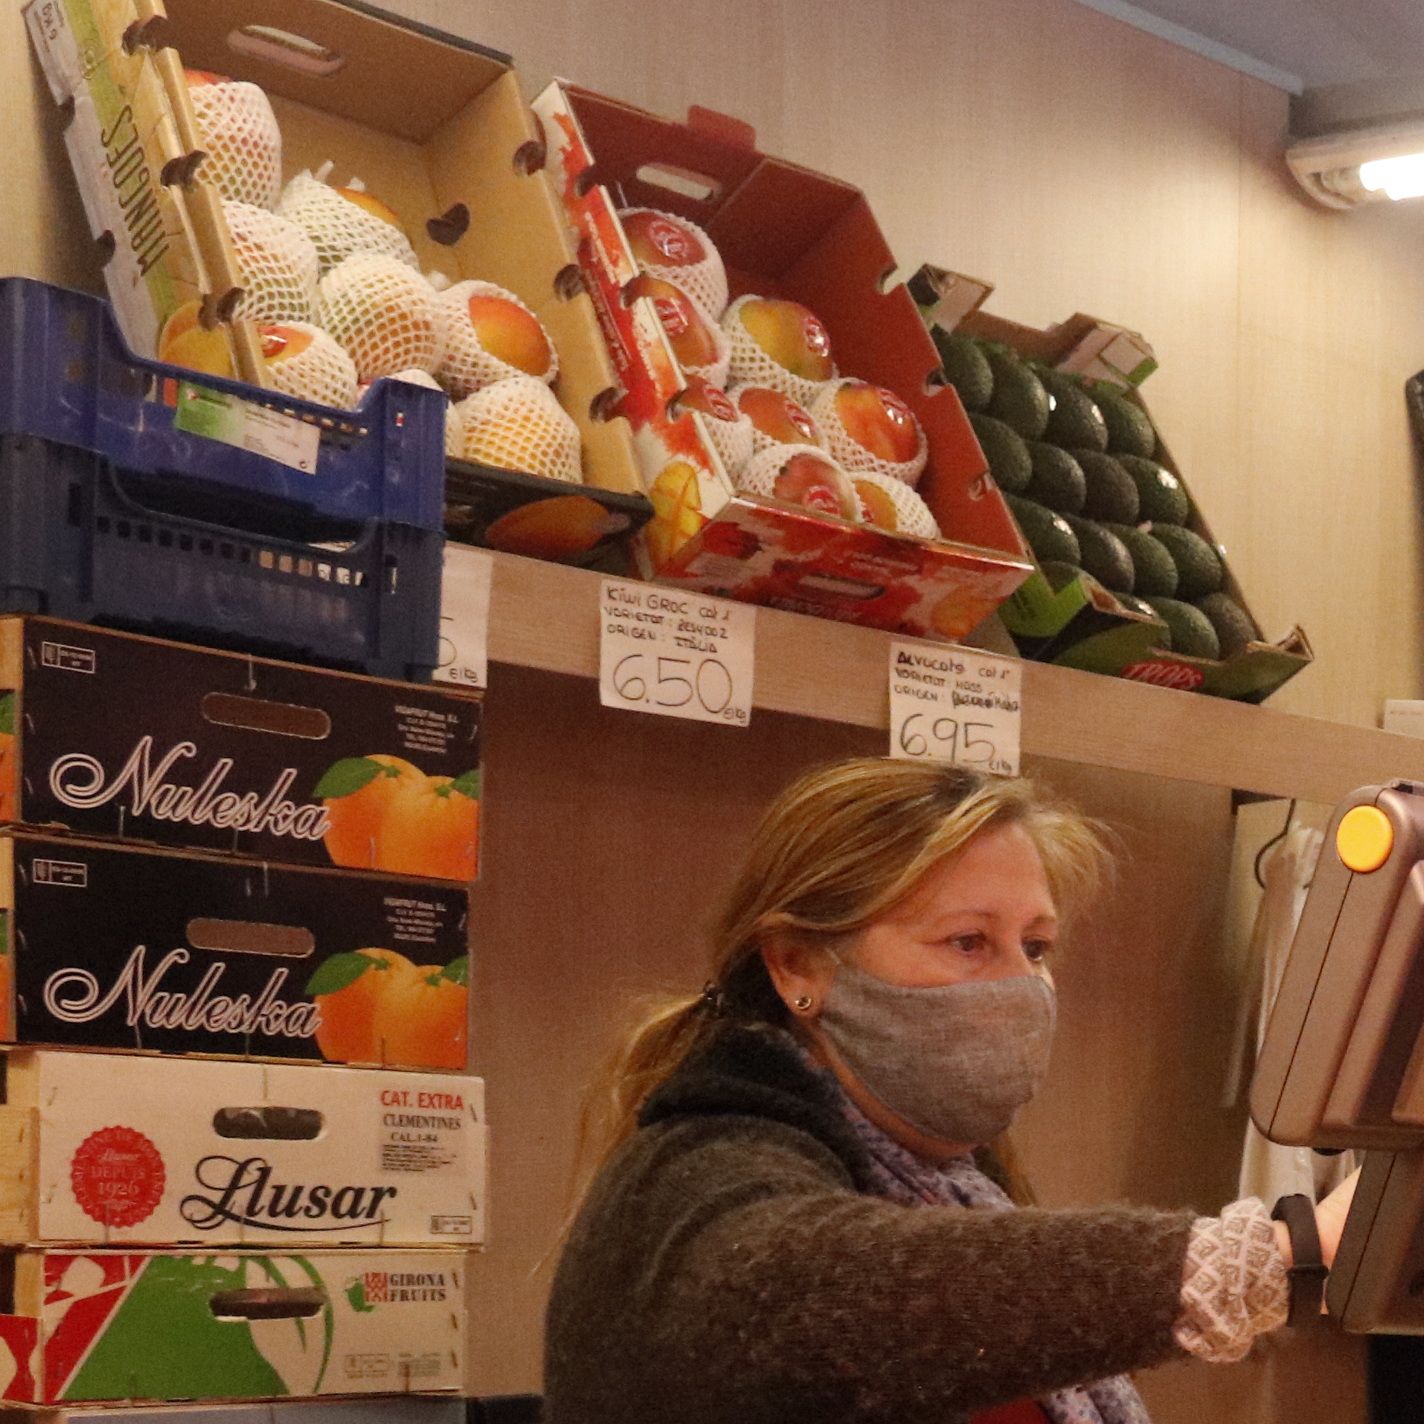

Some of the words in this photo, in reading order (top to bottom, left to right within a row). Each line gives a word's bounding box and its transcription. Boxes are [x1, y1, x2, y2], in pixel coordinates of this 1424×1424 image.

[101, 104, 170, 277] MANGOES
[647, 594, 689, 614] GROC
[612, 653, 733, 714] 6.50
[900, 713, 995, 765] 6.95
[49, 736, 333, 841] Nuleska
[44, 945, 325, 1038] Nuleska
[380, 1090, 413, 1108] CAT.
[418, 1092, 465, 1110] EXTRA
[383, 1114, 462, 1130] CLEMENTINES
[99, 1181, 140, 1197] 1926
[180, 1155, 398, 1232] Llusar
[390, 1273, 445, 1287] GIRONA
[390, 1289, 447, 1303] FRUITS
